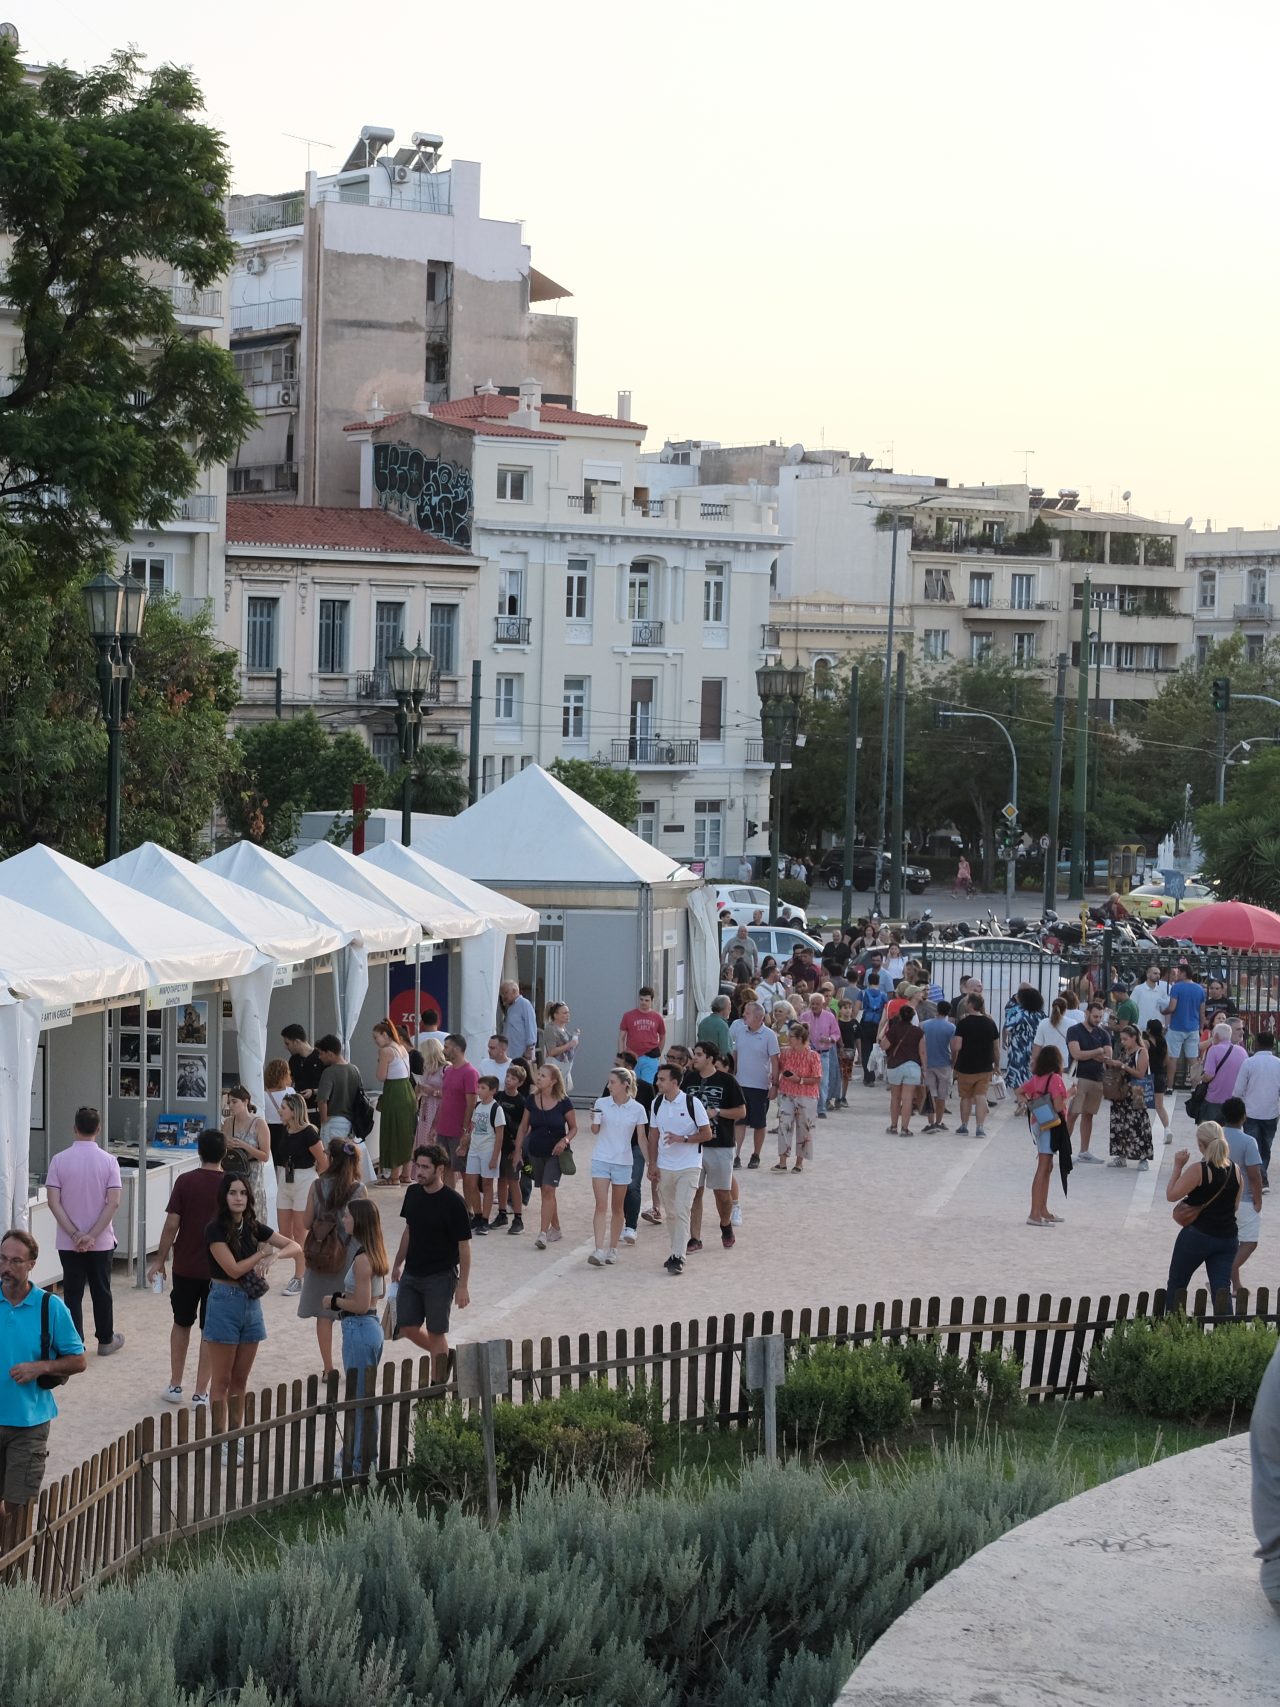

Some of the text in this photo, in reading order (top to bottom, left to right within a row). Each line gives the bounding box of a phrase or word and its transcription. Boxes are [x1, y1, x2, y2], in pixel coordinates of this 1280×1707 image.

[44, 1011, 52, 1023] ART
[52, 1010, 57, 1020] IN
[57, 1007, 71, 1019] GREECE
